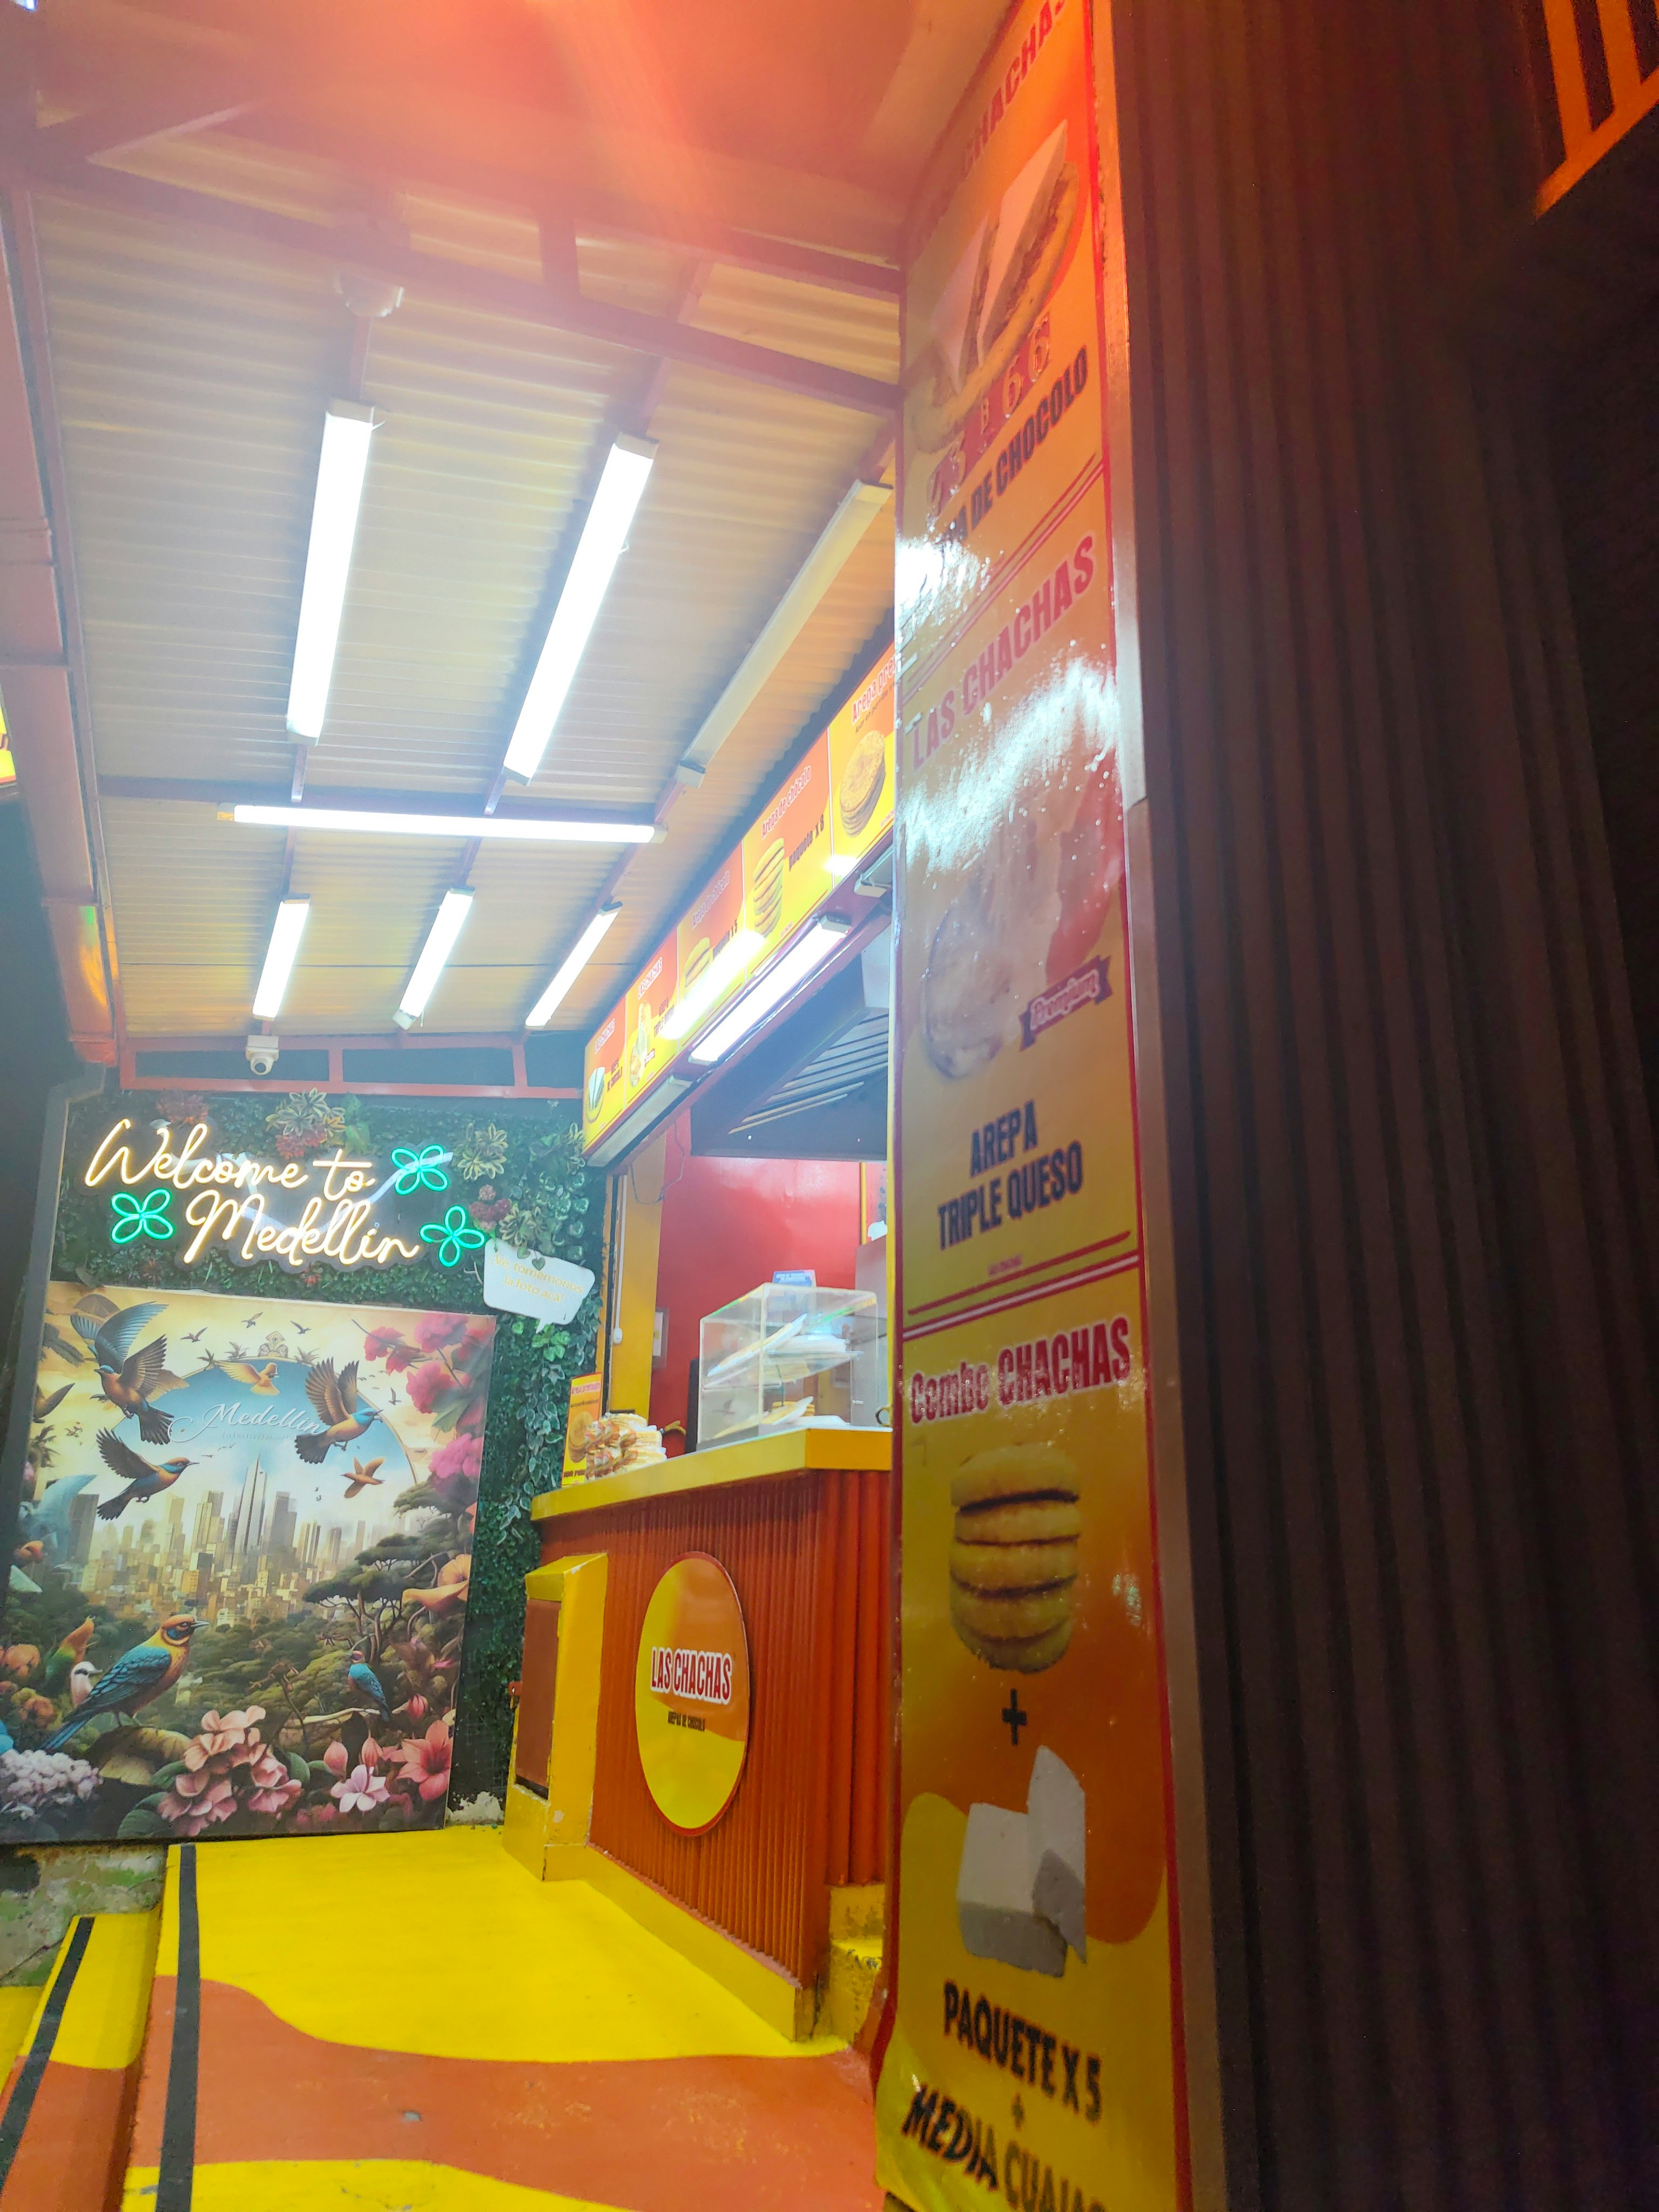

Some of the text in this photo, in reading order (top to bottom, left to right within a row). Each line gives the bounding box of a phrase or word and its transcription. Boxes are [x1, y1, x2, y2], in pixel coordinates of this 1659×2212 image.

[971, 344, 1088, 531] DE CHOCOLO
[913, 535, 1094, 770] LAS CHACHAS
[852, 679, 876, 725] Arepa
[820, 813, 825, 832] 8
[84, 1118, 375, 1202] Welcome to
[970, 1099, 1038, 1178] AREPA
[938, 1140, 1083, 1251] TRIPLE QUESO
[503, 1273, 514, 1287] la
[515, 1278, 540, 1295] foto
[910, 1316, 1131, 1424] Combo CHACHAS
[651, 1648, 731, 1702] LAS CHACHAS
[943, 1979, 1103, 2125] PAQUETE X 5
[901, 2083, 999, 2192] MEDIA
